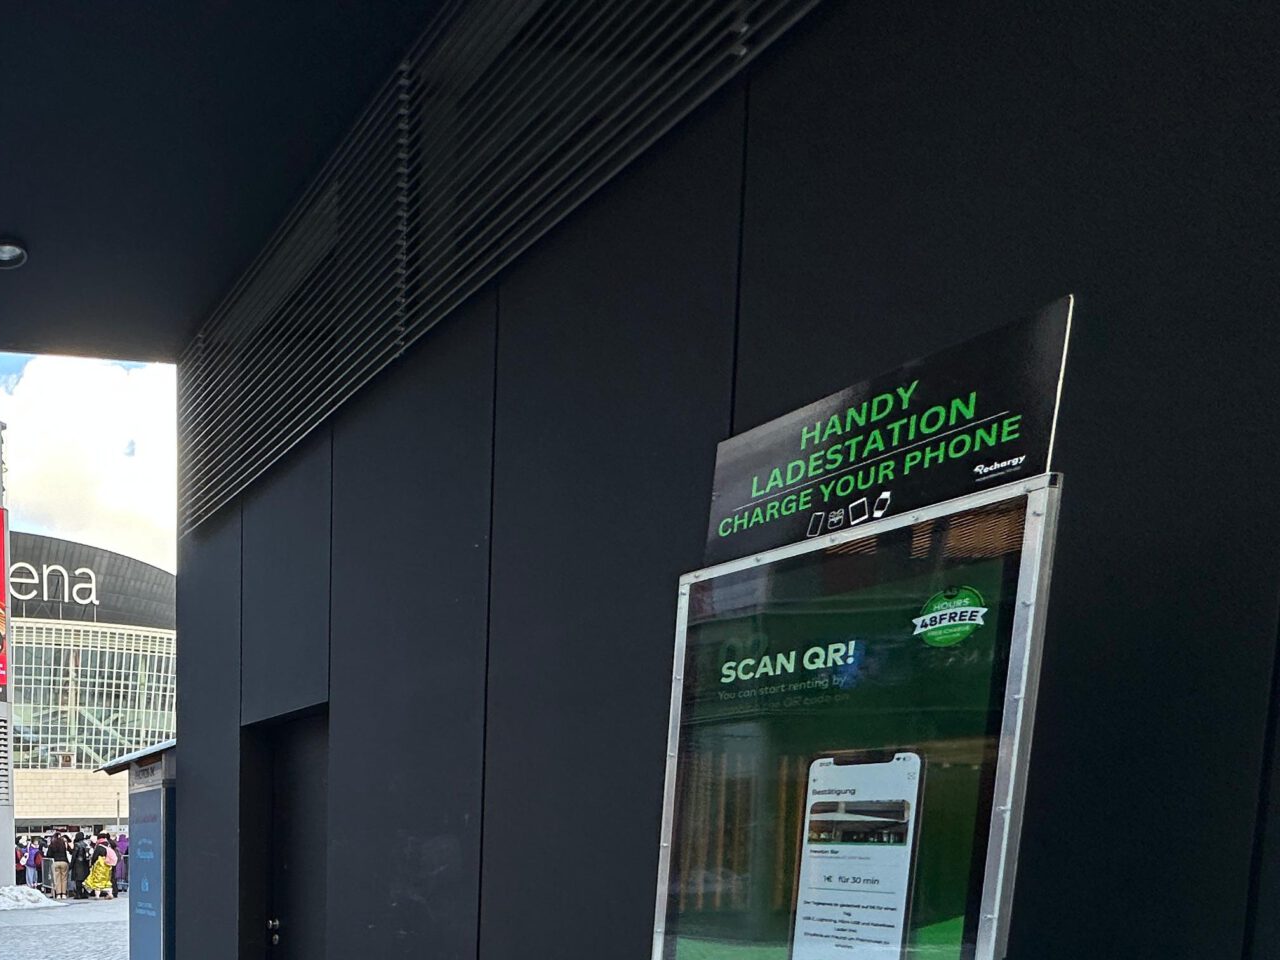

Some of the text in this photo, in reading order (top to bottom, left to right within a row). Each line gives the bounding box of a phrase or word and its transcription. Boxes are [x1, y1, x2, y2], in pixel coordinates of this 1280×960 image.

[800, 380, 919, 451] HANDY
[751, 392, 976, 498] LADESTATION
[718, 415, 1022, 537] CHARGE YOUR PHONE
[973, 455, 1026, 475] Rechargy
[9, 561, 100, 605] ena
[920, 610, 979, 628] 48FREE
[721, 640, 856, 683] SCAN QR!
[717, 674, 847, 701] You can start renting by
[811, 787, 857, 796] Bestätigung
[838, 875, 850, 884] für
[850, 875, 862, 885] 30
[862, 876, 880, 886] min
